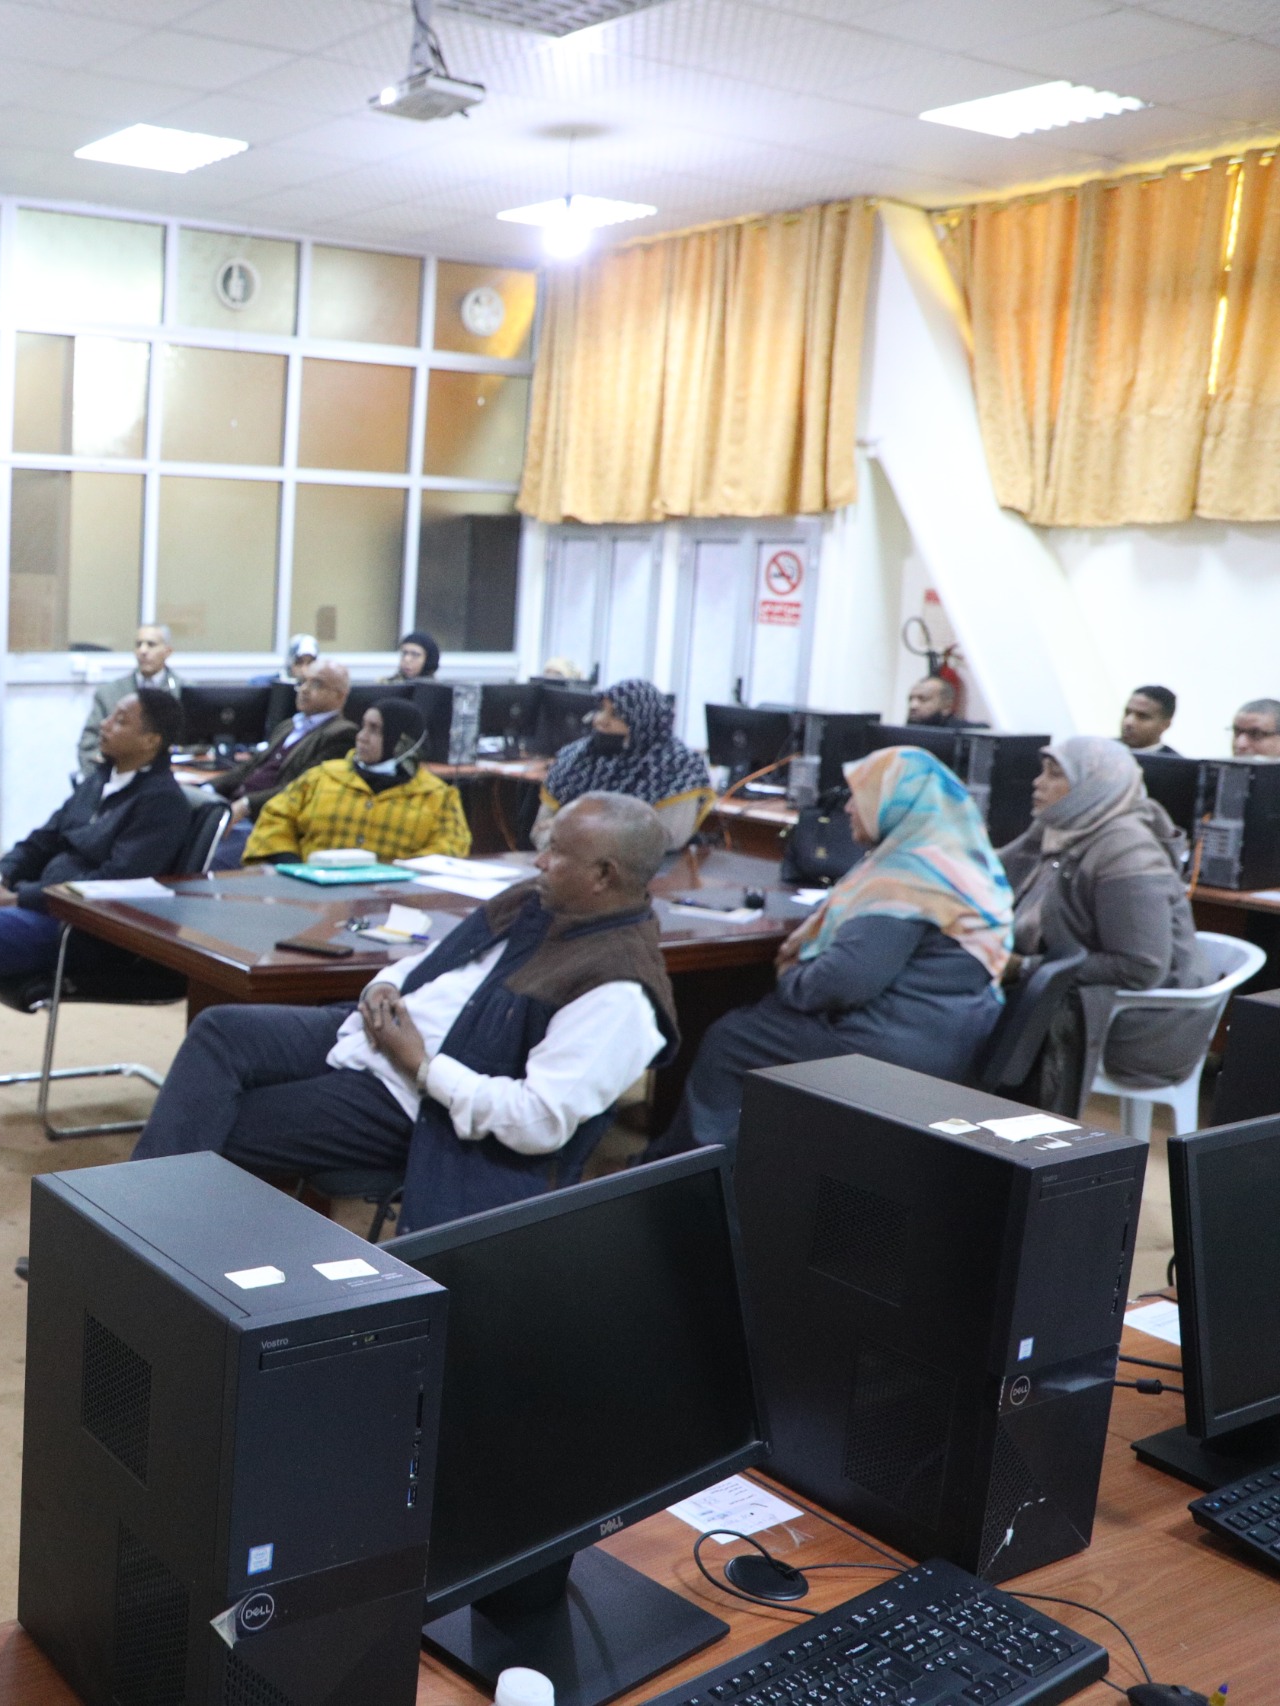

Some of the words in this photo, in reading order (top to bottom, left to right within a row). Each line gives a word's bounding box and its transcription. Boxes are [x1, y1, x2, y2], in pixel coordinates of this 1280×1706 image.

[261, 1337, 289, 1350] Vostro
[1012, 1385, 1028, 1396] DELL
[599, 1515, 624, 1536] DELL
[245, 1604, 271, 1620] DELL
